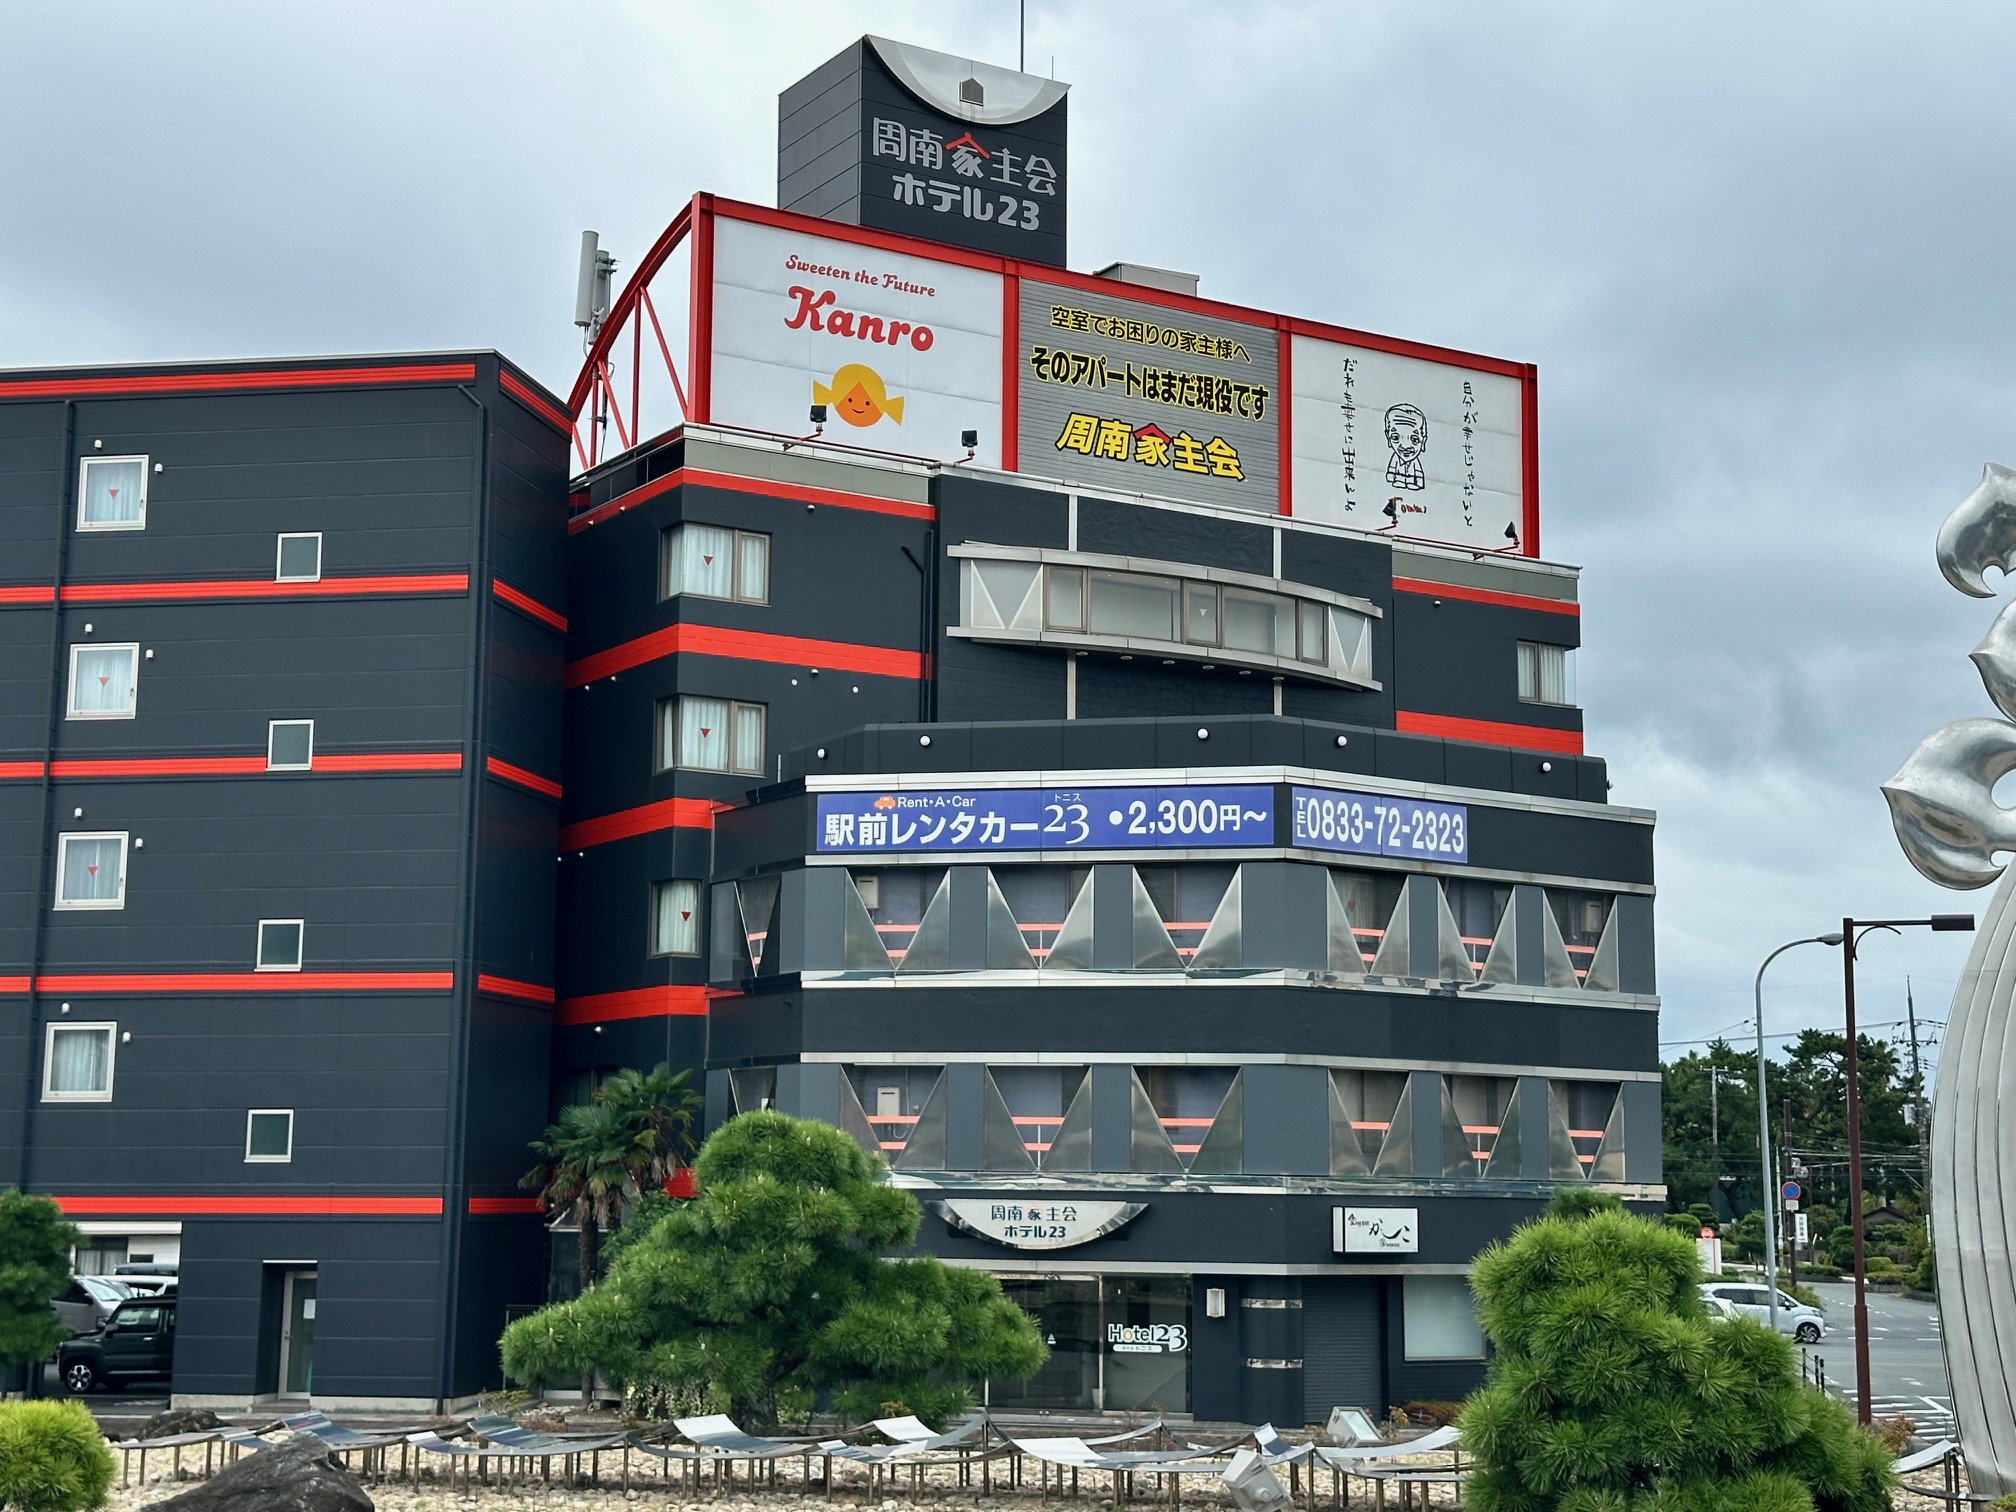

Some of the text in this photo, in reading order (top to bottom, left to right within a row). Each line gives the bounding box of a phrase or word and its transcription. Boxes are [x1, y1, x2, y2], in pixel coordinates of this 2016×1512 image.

[873, 116, 1057, 196] 周南家主会
[892, 173, 1040, 231] ホテル23
[785, 254, 936, 297] Sweeten the Future
[784, 285, 934, 351] Kanro
[1051, 305, 1251, 364] 空室でお困りの家主様へ
[1030, 345, 1269, 420] そのアパートはまだ現役です
[1055, 412, 1246, 482] 周南家主会
[1053, 792, 1082, 802] トニス
[1295, 796, 1465, 854] TEL 0833-72-2323
[991, 1202, 1077, 1222] 周南家主会
[1004, 1225, 1066, 1238] ホテル23
